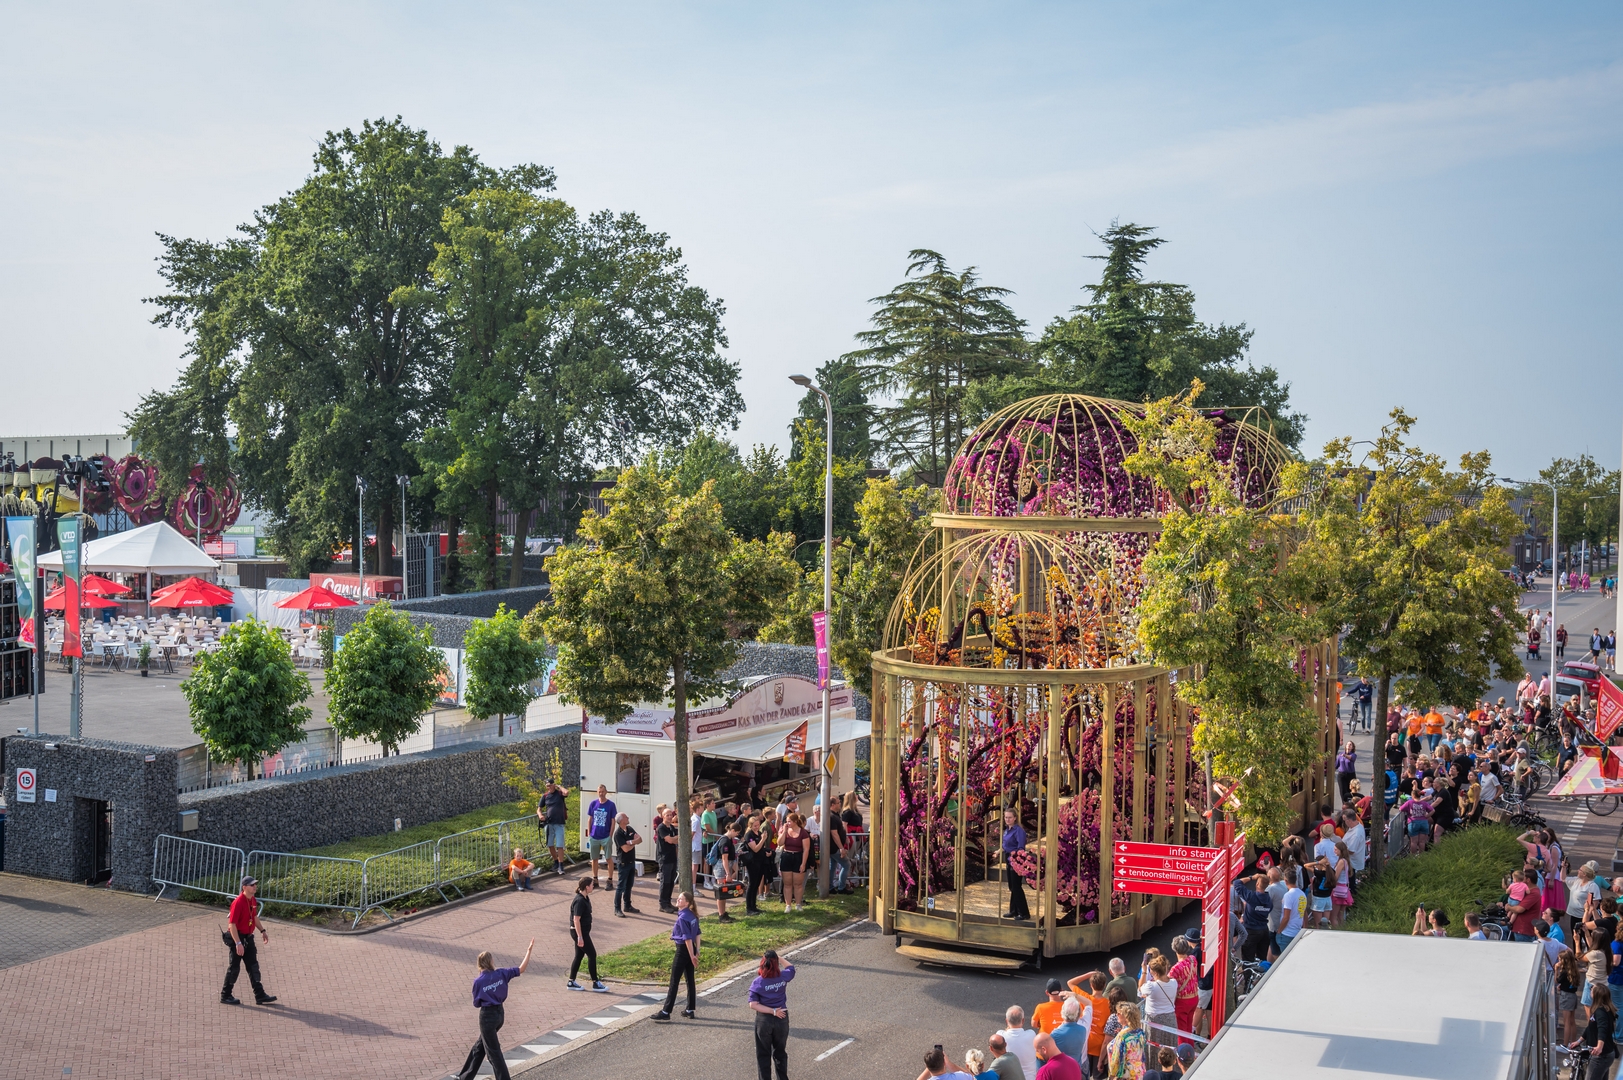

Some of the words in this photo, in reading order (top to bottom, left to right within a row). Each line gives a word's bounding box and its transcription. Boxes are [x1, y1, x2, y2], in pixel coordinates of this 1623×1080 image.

[752, 713, 766, 725] VAN
[766, 711, 779, 721] DER
[779, 705, 800, 718] ZANDE
[22, 776, 30, 784] 15
[1169, 847, 1187, 857] info
[1190, 849, 1217, 859] stand
